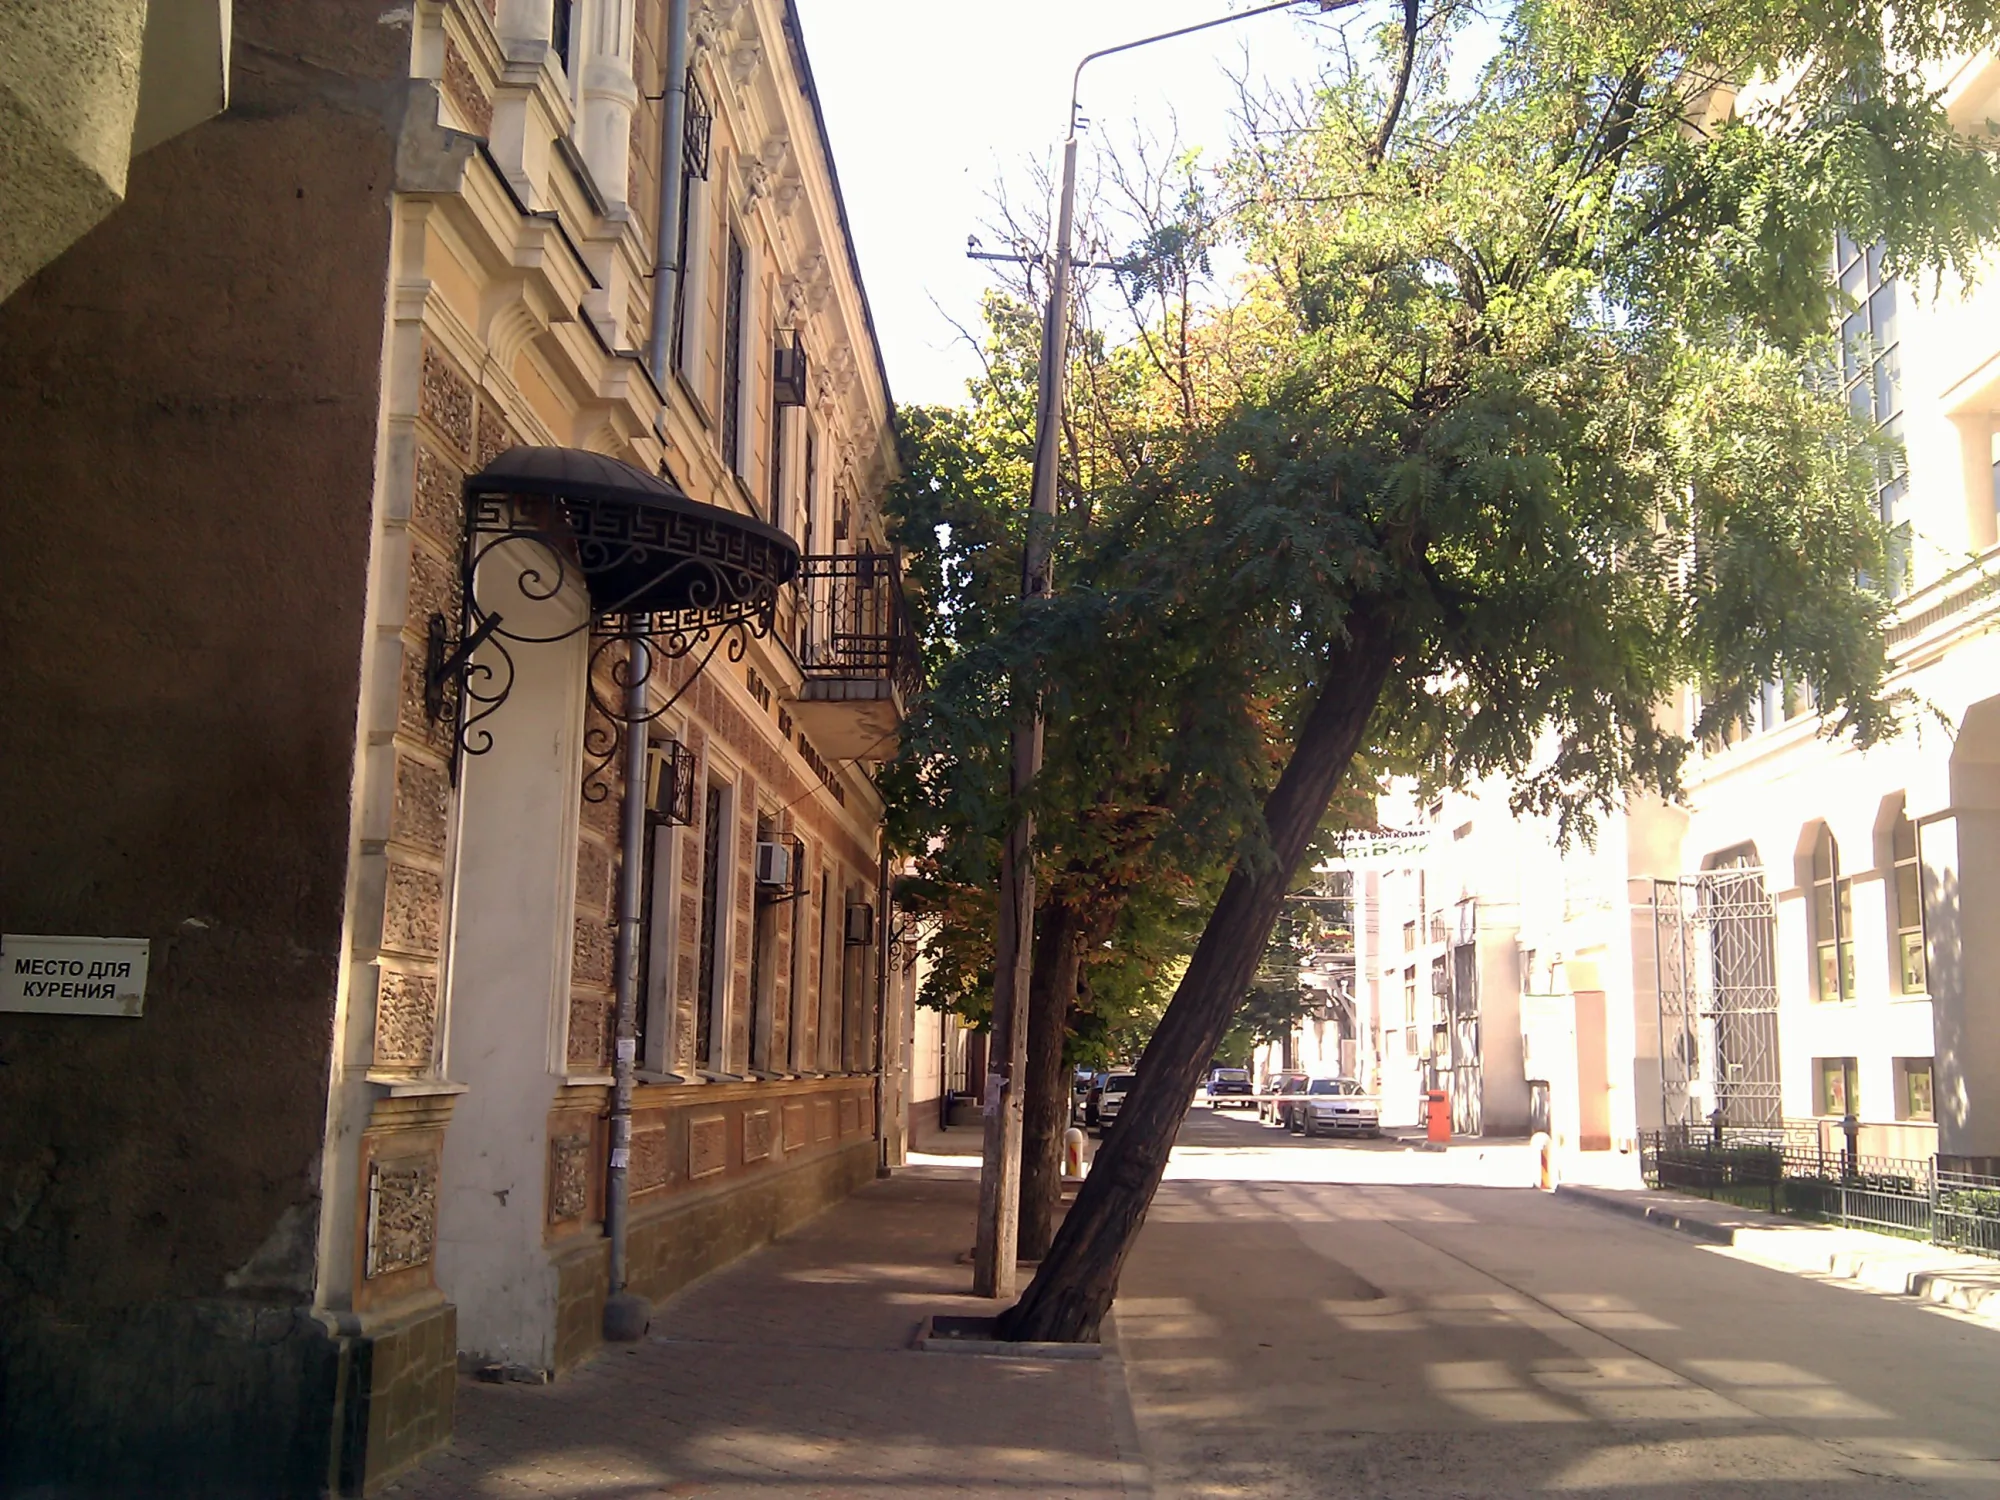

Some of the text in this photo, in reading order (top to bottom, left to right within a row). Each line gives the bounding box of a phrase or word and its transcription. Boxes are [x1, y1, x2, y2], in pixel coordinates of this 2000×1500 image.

[14, 959, 131, 980] МЕСТО ДЛЯ
[23, 981, 116, 999] КУРЕНИЯ
